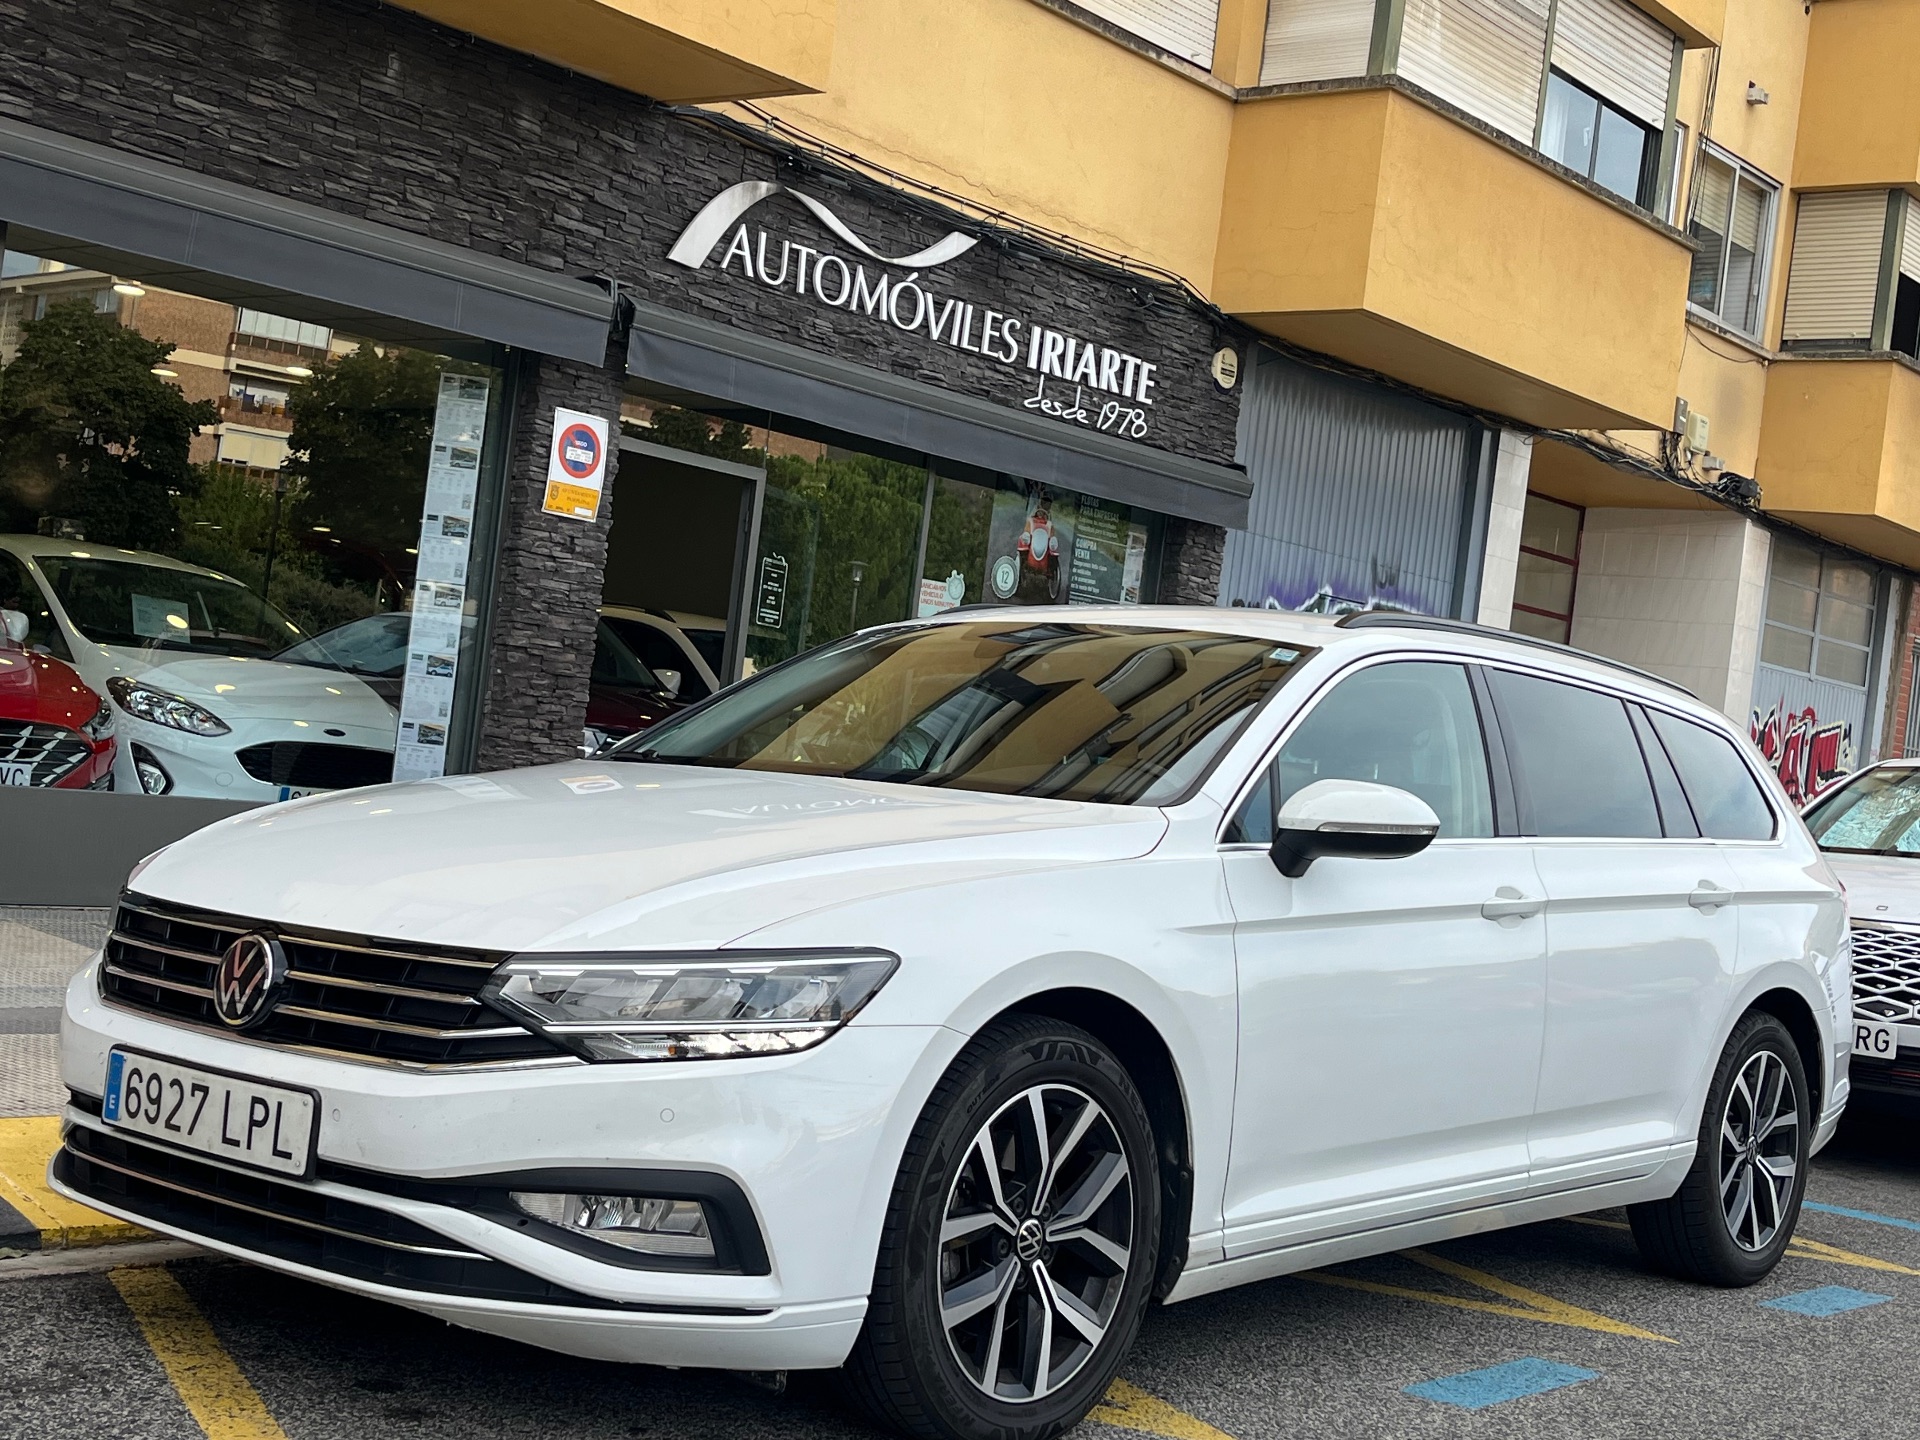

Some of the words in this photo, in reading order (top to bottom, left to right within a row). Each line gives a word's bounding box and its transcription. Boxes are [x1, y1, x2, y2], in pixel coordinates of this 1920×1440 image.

[720, 223, 1019, 363] AUTOMÓVILES
[1026, 325, 1157, 404] IRIARTE
[1024, 374, 1088, 424] desde
[1096, 401, 1148, 438] 1978
[1081, 494, 1099, 507] FLOTAS
[1079, 505, 1093, 516] PARA
[1094, 509, 1119, 523] EMPRESAS
[1075, 538, 1097, 551] COMPRA
[1074, 548, 1090, 560] VENTA
[1001, 570, 1010, 584] 12
[1855, 1025, 1890, 1053] RG
[108, 1094, 116, 1109] E
[124, 1067, 209, 1136] 6927
[220, 1089, 293, 1160] LPL
